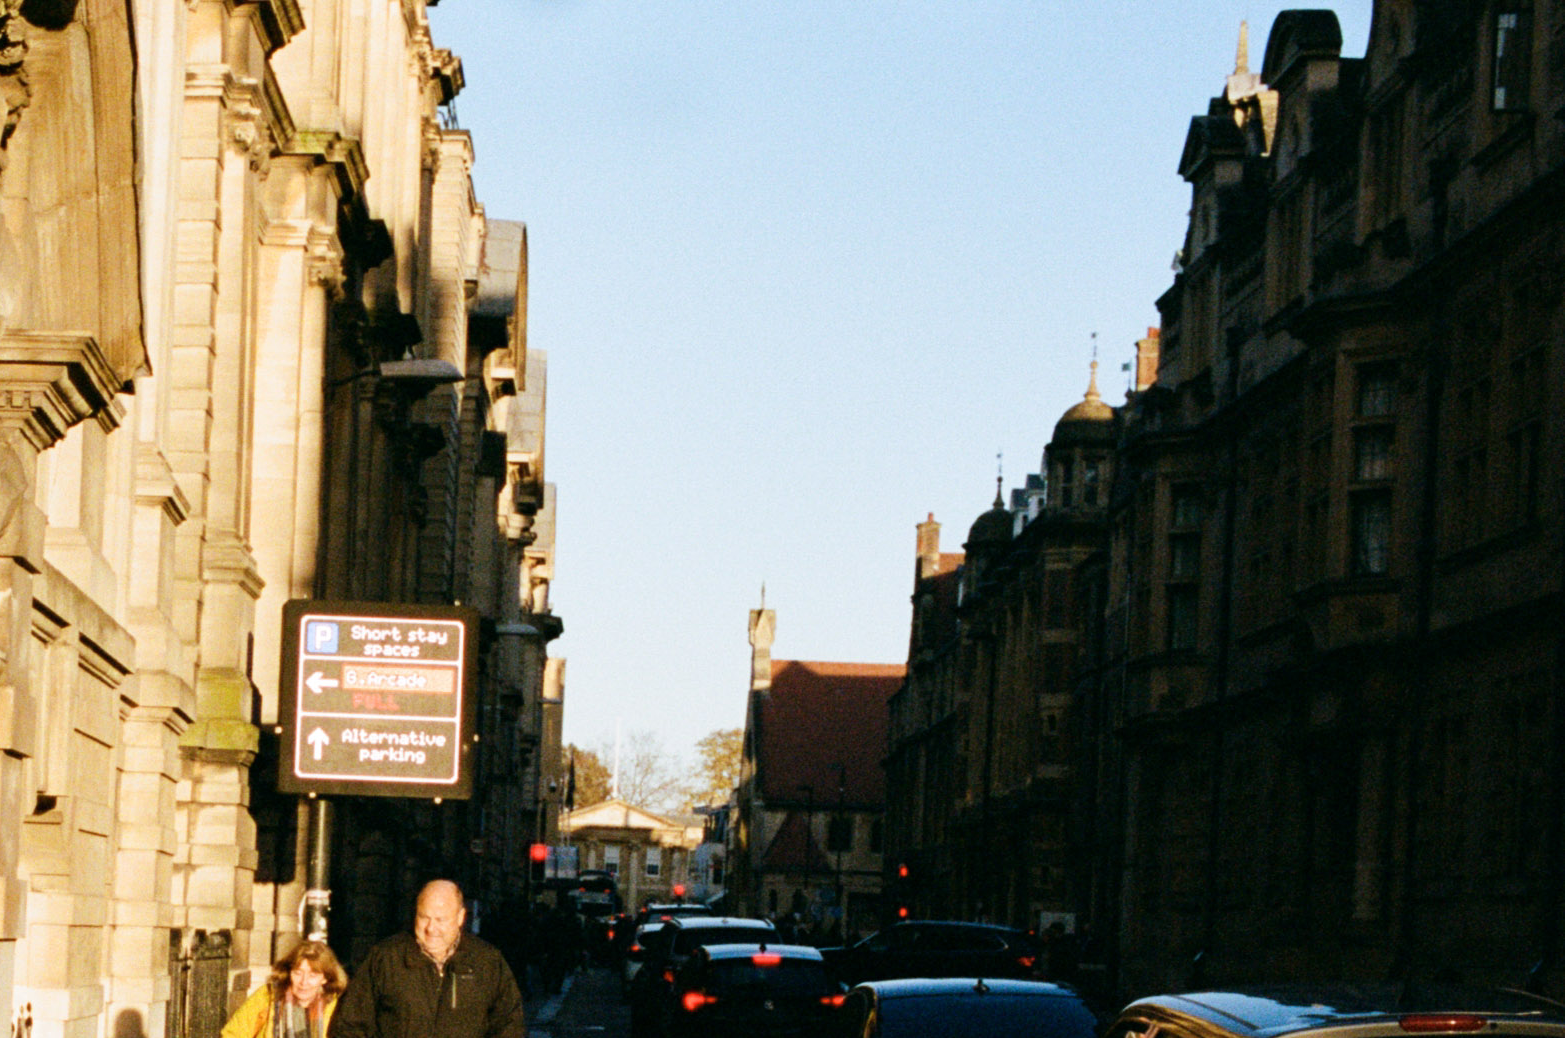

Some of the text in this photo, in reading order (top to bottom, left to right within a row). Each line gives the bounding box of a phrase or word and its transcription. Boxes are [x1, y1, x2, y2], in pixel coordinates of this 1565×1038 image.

[314, 625, 332, 650] P
[350, 625, 448, 645] Short stay
[363, 643, 420, 658] spaces
[352, 693, 400, 711] FULL
[341, 728, 447, 748] Alternative
[359, 747, 426, 764] parking
